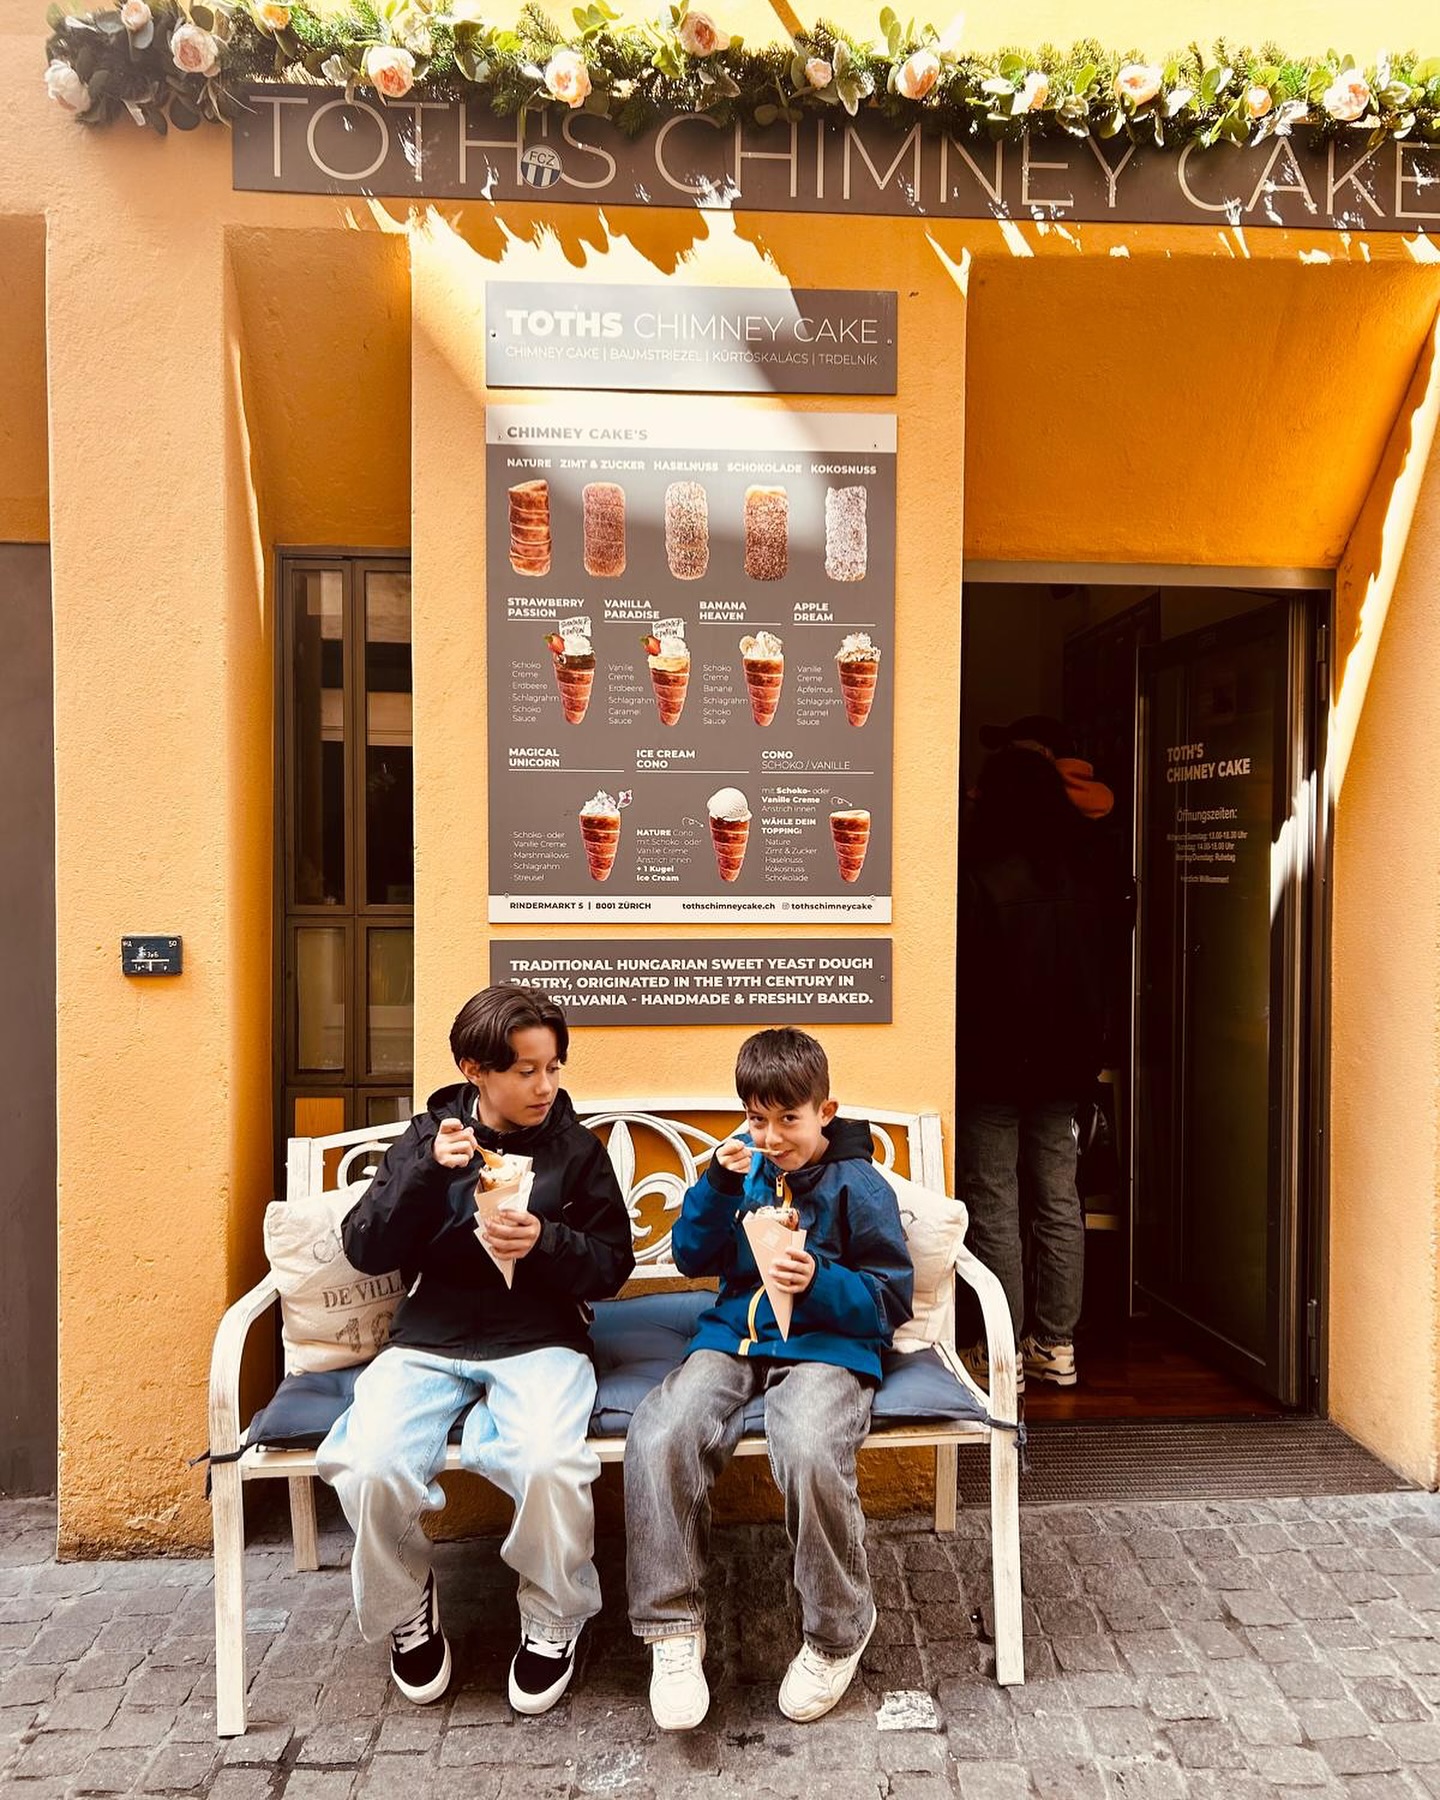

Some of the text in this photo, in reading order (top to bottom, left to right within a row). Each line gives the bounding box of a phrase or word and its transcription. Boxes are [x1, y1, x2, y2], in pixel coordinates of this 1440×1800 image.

[249, 95, 1440, 219] TOTH'S CHIMNEY CAKE
[529, 150, 556, 167] FCZ
[506, 310, 878, 344] TOTHS CHIMNEY CAKE
[506, 346, 564, 360] CHIMNEY
[566, 348, 599, 360] CAKE
[610, 350, 702, 362] BAUMSTRIEZEL
[819, 352, 878, 366] TRDELNÍK
[507, 426, 648, 441] CHIMNEY CAKE'S
[507, 458, 551, 469] NATURE
[560, 459, 645, 471] ZIMT & ZUCKER
[653, 461, 718, 472] HASELNUSS
[727, 462, 802, 474] SCHOKOLADE
[811, 463, 877, 475] KOKOSNUSS
[507, 597, 585, 608] STRAWBERRY
[604, 600, 652, 609] VANILLA
[700, 601, 747, 610] BANANA
[793, 602, 829, 612] APPLE
[508, 608, 556, 617] PASSION
[604, 610, 660, 620] PARADISE
[700, 611, 744, 621] HEAVEN
[794, 612, 833, 622] DREAM
[511, 660, 541, 669] Schoko
[702, 664, 732, 673] Schoko
[511, 671, 538, 679] Creme
[608, 673, 634, 681] Creme
[702, 674, 729, 682] Creme
[512, 681, 548, 690] Erdbeere
[608, 684, 643, 693] Erdbeere
[796, 685, 833, 694] Apfelmus
[512, 693, 560, 703] Schlagrahm
[608, 696, 655, 706] Schlagrahm
[703, 696, 749, 706] Schlagrahm
[797, 697, 843, 707] Schlagrahm
[703, 708, 732, 716] Schoko
[797, 708, 829, 717] Caramel
[512, 714, 536, 722] Sauce
[608, 717, 632, 725] Sauce
[509, 748, 560, 758] MAGICAL
[636, 749, 695, 759] ICE CREAM
[761, 750, 793, 760] CONO
[1167, 743, 1204, 762] TOTH'S
[509, 758, 560, 767] UNICORN
[636, 759, 668, 769] CONO
[761, 760, 804, 770] SCHOKO
[811, 760, 851, 770] VANILLE
[1167, 758, 1251, 783] CHIMNEY CAKE
[776, 786, 811, 795] Schoko-
[761, 795, 820, 804] Vanille Creme
[761, 816, 817, 826] WÄHLE DEIN
[546, 831, 565, 839] oder
[636, 829, 671, 837] NATURE
[761, 827, 802, 836] TOPPING:
[540, 841, 567, 849] Creme
[765, 837, 791, 846] Nature
[512, 862, 560, 872] Schlagrahm
[649, 865, 674, 874] Kugel
[513, 873, 545, 882] Streusel
[636, 873, 680, 882] Ice Cream
[765, 873, 809, 883] Schokolade
[510, 901, 575, 911] RINDERMARKT
[595, 901, 616, 911] 8001
[618, 899, 651, 911] ZÜRICH
[682, 901, 775, 913] tothschimneycake.ch
[792, 901, 873, 913] tothschimneycake
[510, 958, 873, 971] TRADITIONAL HUNGARIAN SWEET YEAST DOUGH
[576, 976, 670, 989] ORIGINATED
[674, 976, 690, 988] IN
[694, 976, 723, 987] THE
[727, 976, 761, 987] 17TH
[765, 975, 835, 987] CENTURY
[839, 975, 854, 987] IN
[548, 994, 628, 1006] SYLVANIA
[641, 993, 731, 1005] HANDMADE
[734, 993, 745, 1005] &
[749, 993, 814, 1004] FRESHLY
[818, 992, 874, 1004] BAKED.
[322, 1287, 352, 1308] DE
